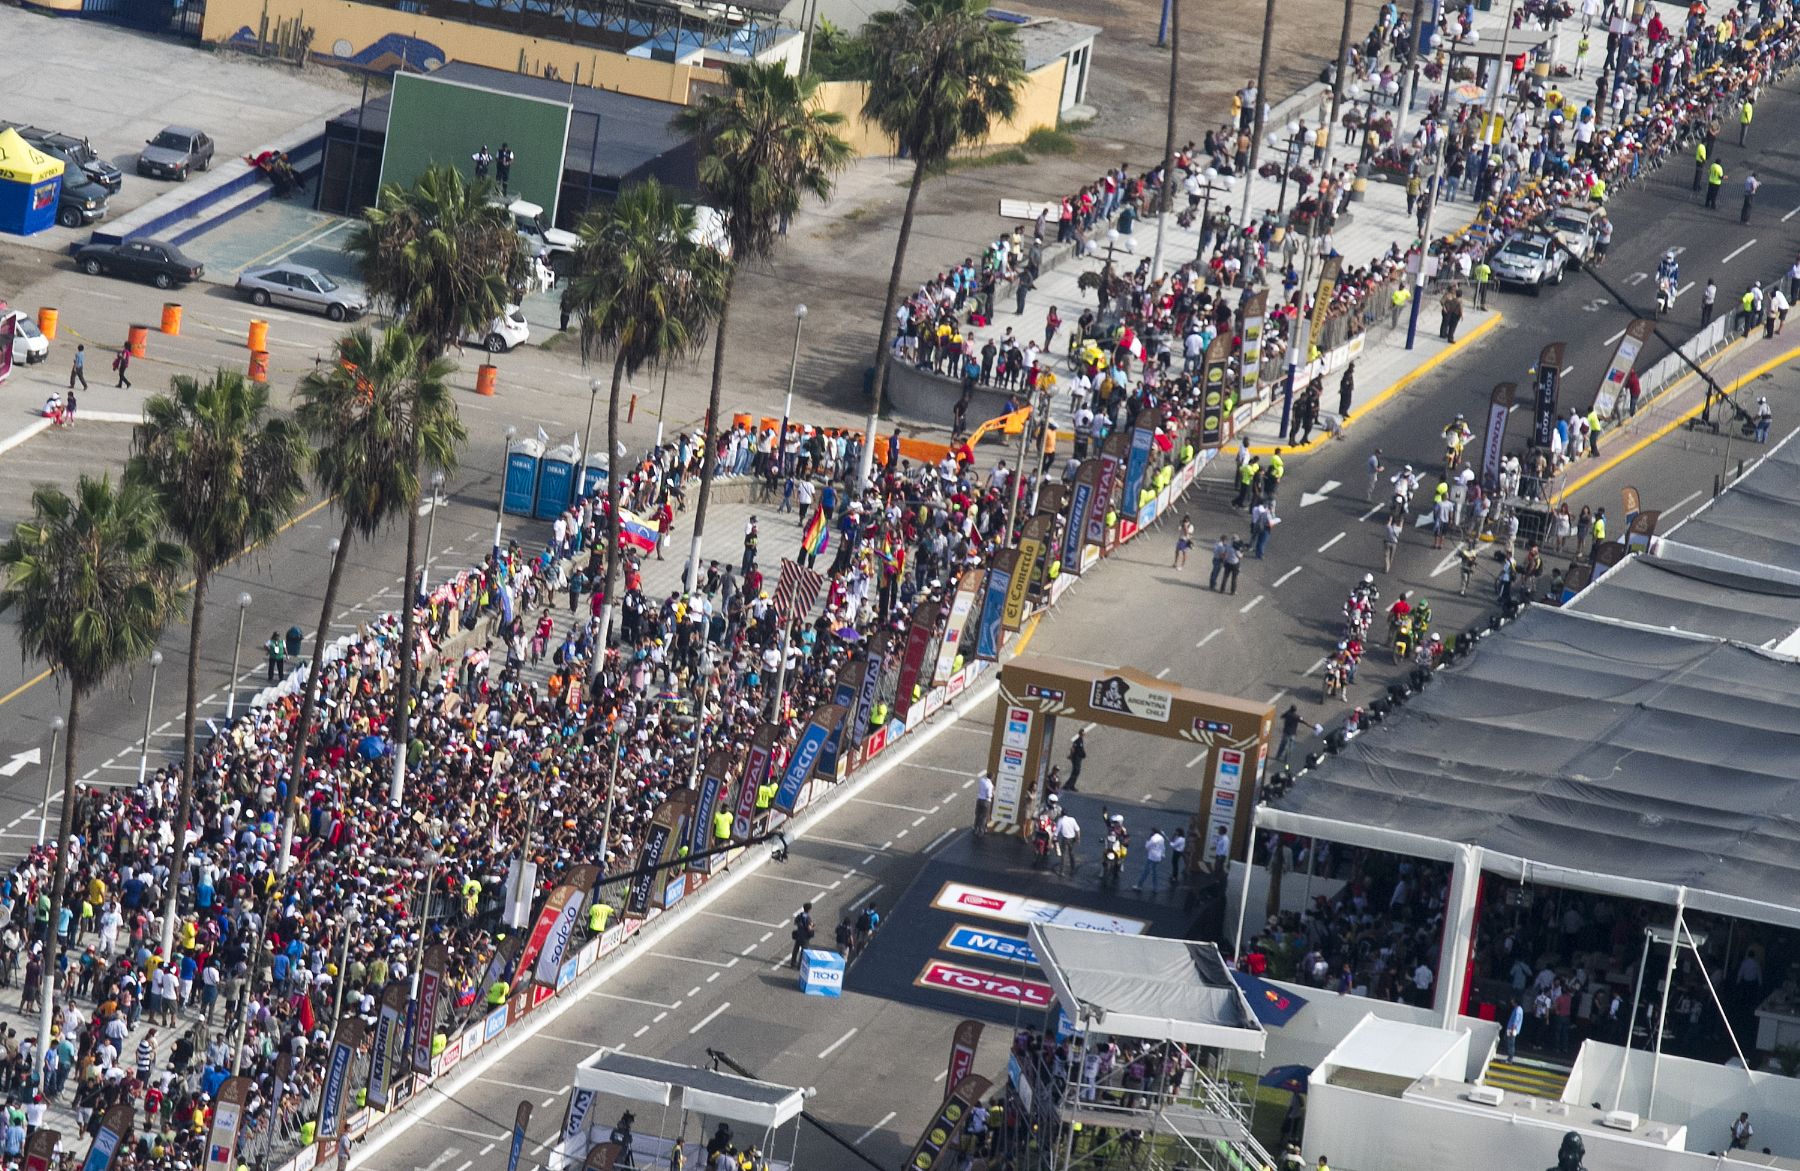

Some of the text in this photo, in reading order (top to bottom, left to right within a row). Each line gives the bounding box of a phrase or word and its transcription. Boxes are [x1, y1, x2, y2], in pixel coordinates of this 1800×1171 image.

[1490, 410, 1505, 466] HONDA
[1069, 487, 1087, 549] MICHELIN
[1093, 462, 1114, 518] TOTAL
[741, 754, 764, 815] TOTAL
[783, 739, 819, 795] Macro
[696, 780, 716, 847] MICHELIN
[647, 831, 664, 868] EDOX
[636, 875, 651, 910] EDOX
[551, 906, 577, 966] sodexo
[812, 970, 839, 981] TECHO
[936, 968, 1044, 1001] TOTAL
[420, 978, 436, 1039] TOTAL
[325, 1048, 346, 1111] MICHELIN
